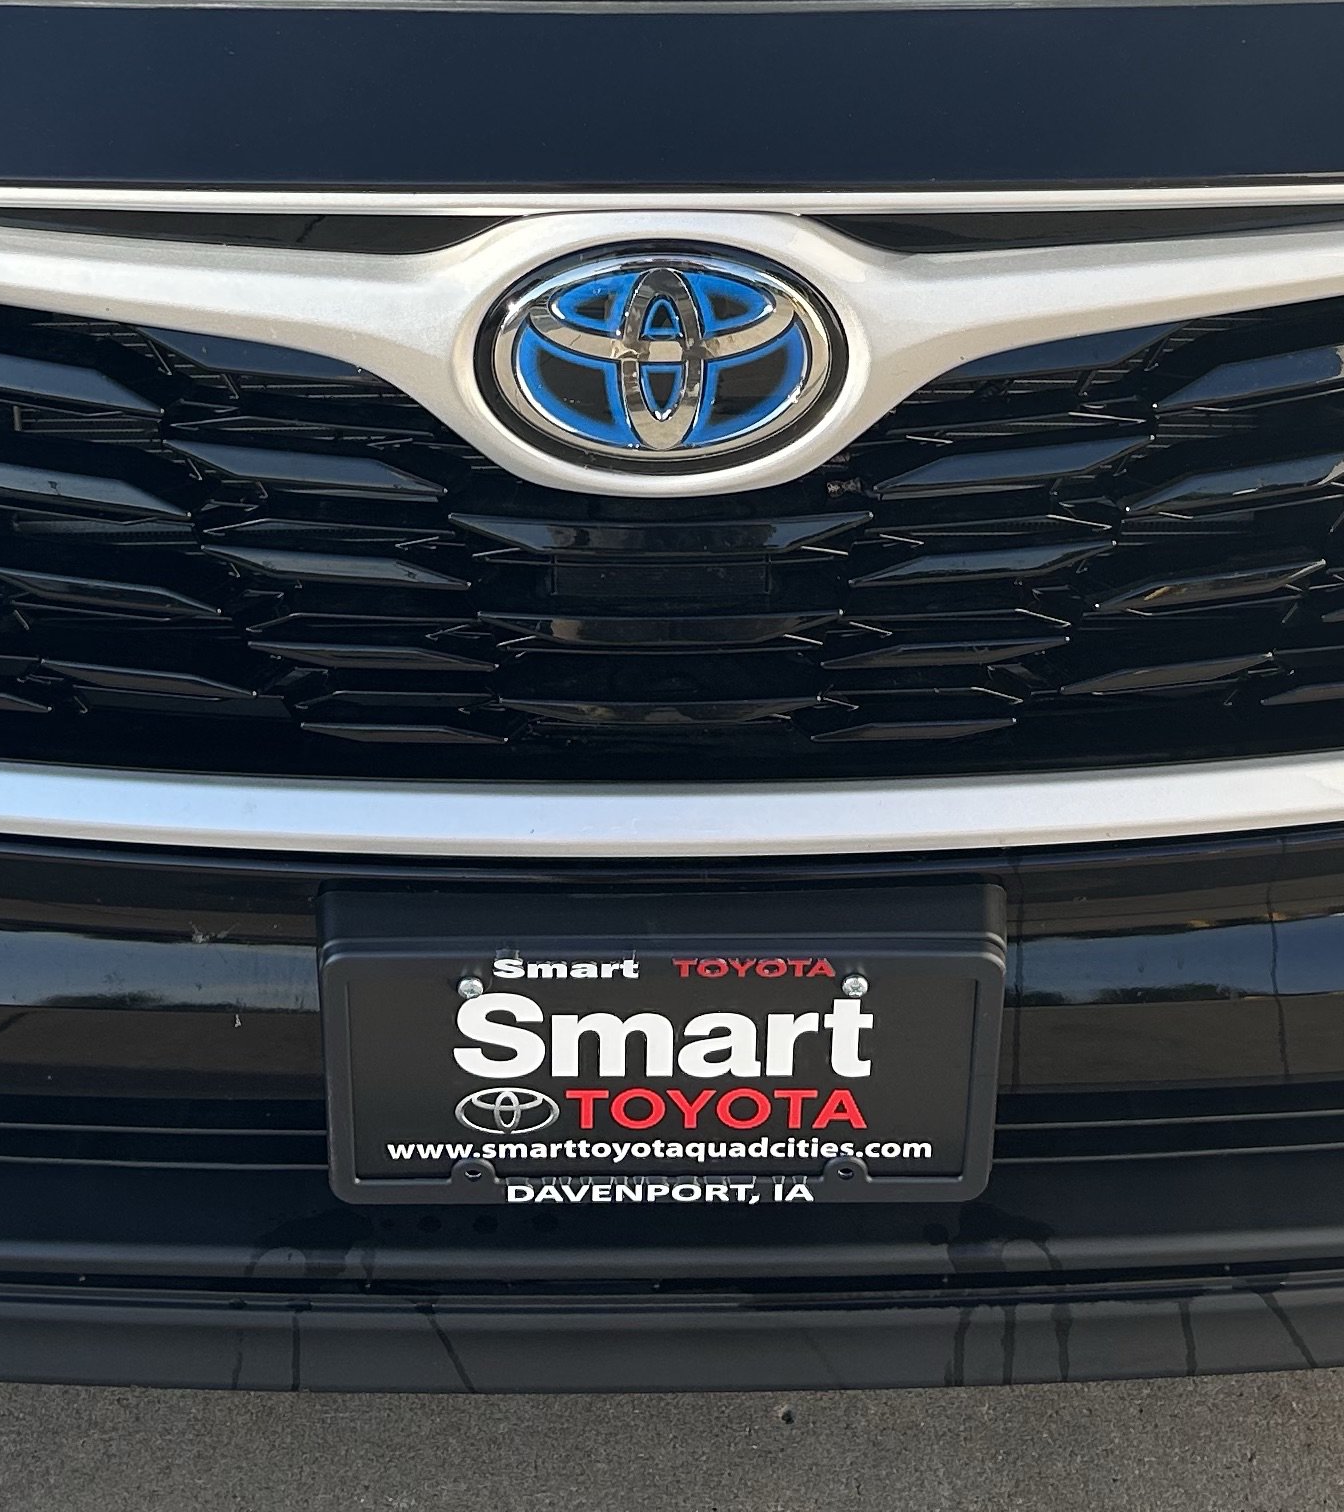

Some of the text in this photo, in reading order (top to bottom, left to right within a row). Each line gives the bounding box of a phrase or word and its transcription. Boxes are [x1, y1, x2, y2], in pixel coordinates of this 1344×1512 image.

[492, 956, 837, 980] Smart TOYOTA
[453, 993, 874, 1079] Smart
[566, 1088, 868, 1130] TOYOTA
[387, 1136, 933, 1163] www.smarttoyotaquadcities.com
[506, 1180, 815, 1206] DAVENPORT, IA
